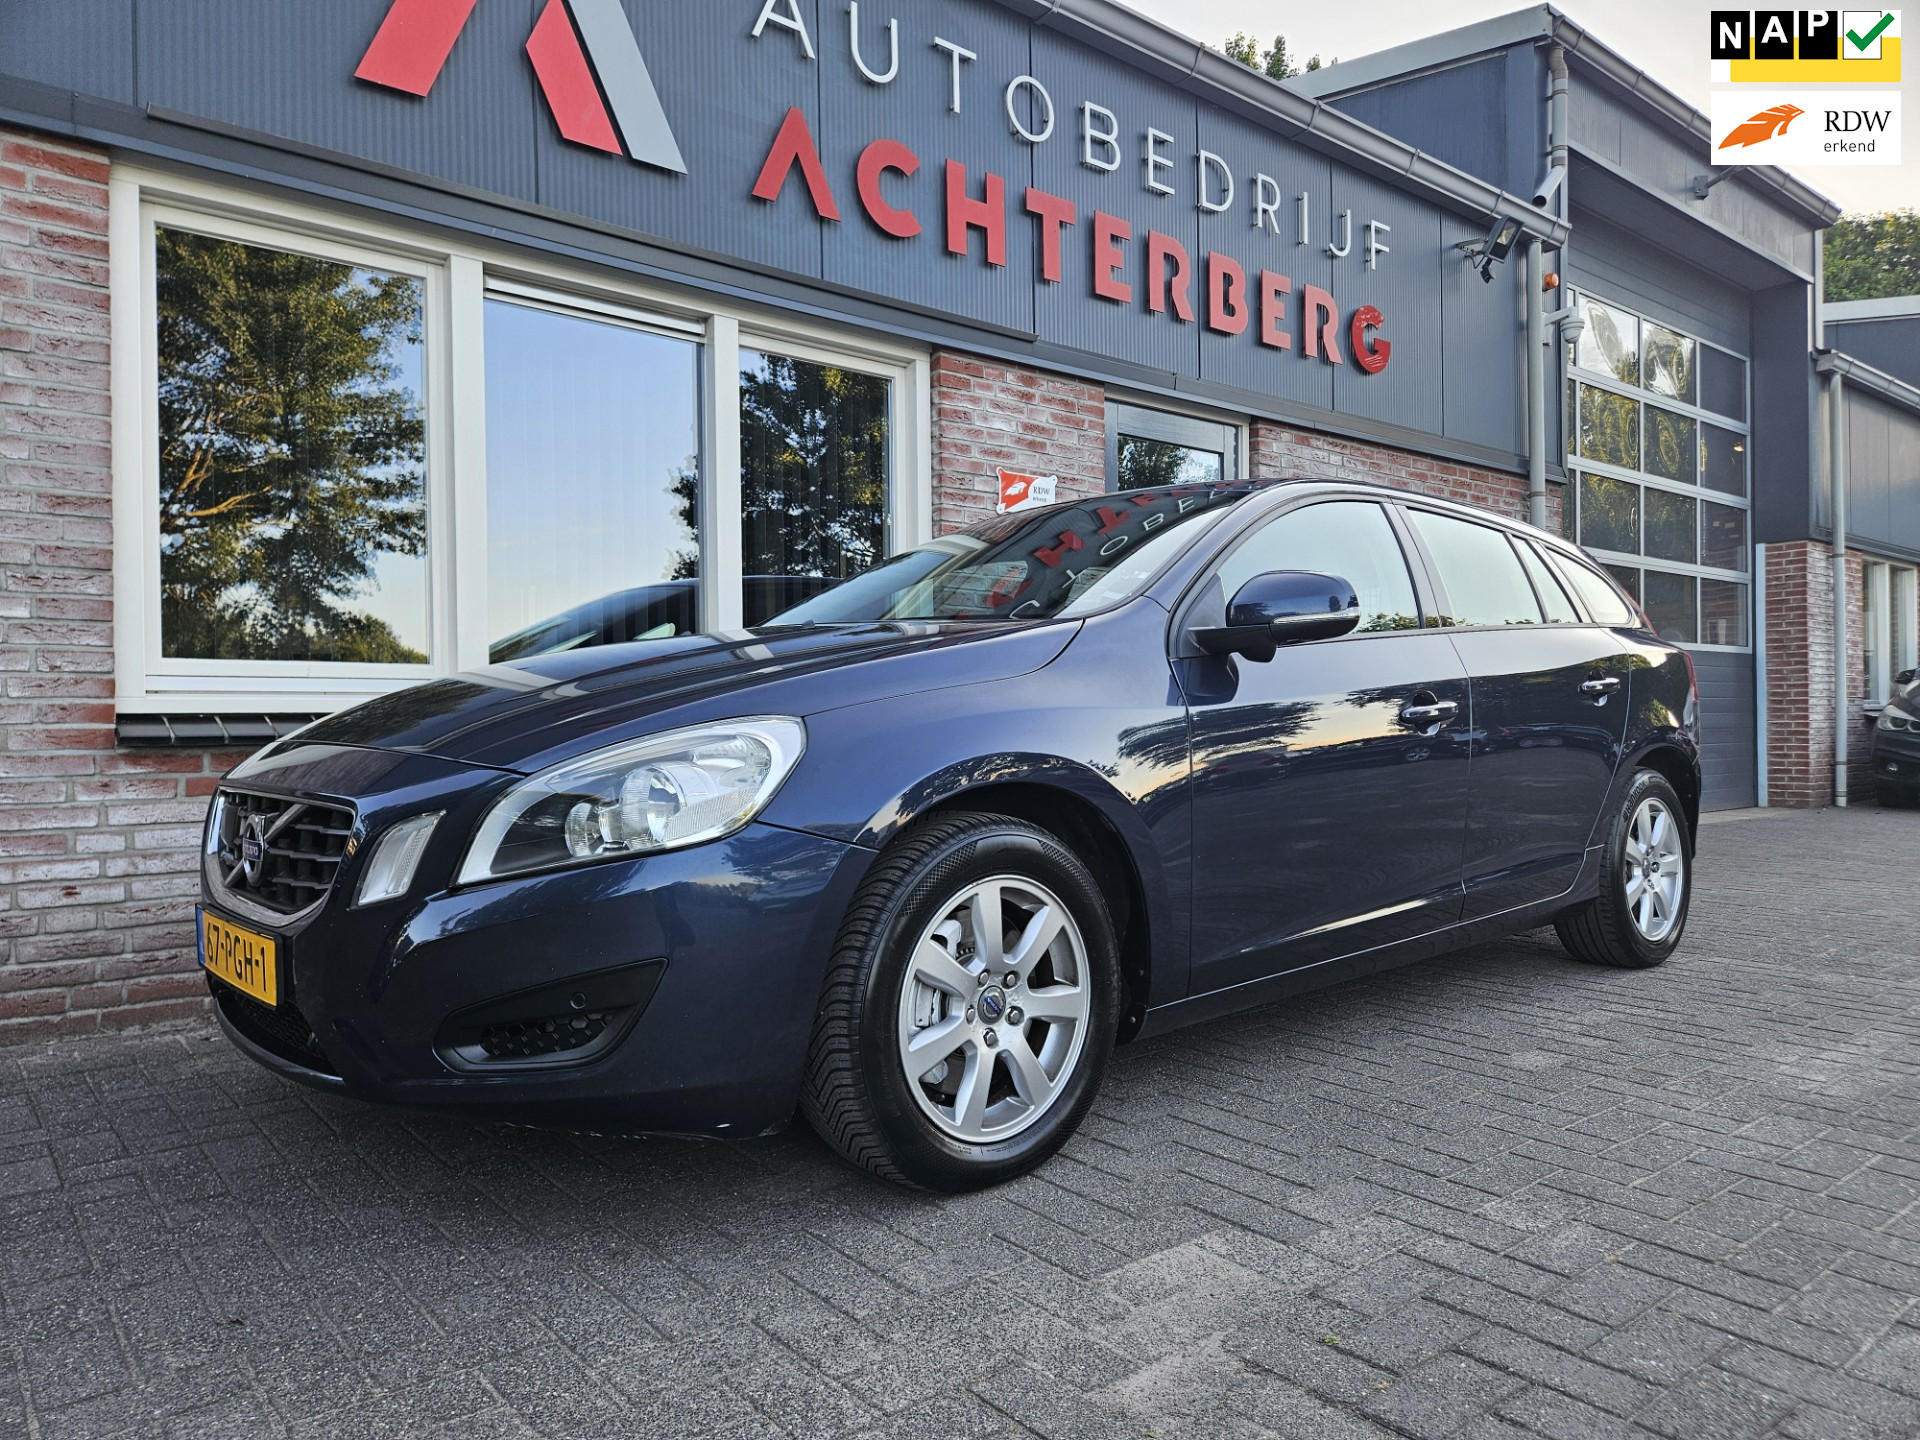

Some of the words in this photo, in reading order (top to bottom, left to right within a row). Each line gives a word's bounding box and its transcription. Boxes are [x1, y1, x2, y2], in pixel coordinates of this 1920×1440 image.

[751, 0, 1391, 272] AUTOBEDRIJF
[751, 106, 1391, 374] ACHTERBERG
[1033, 486, 1050, 495] RDW
[207, 921, 267, 992] 67-PGH-1
